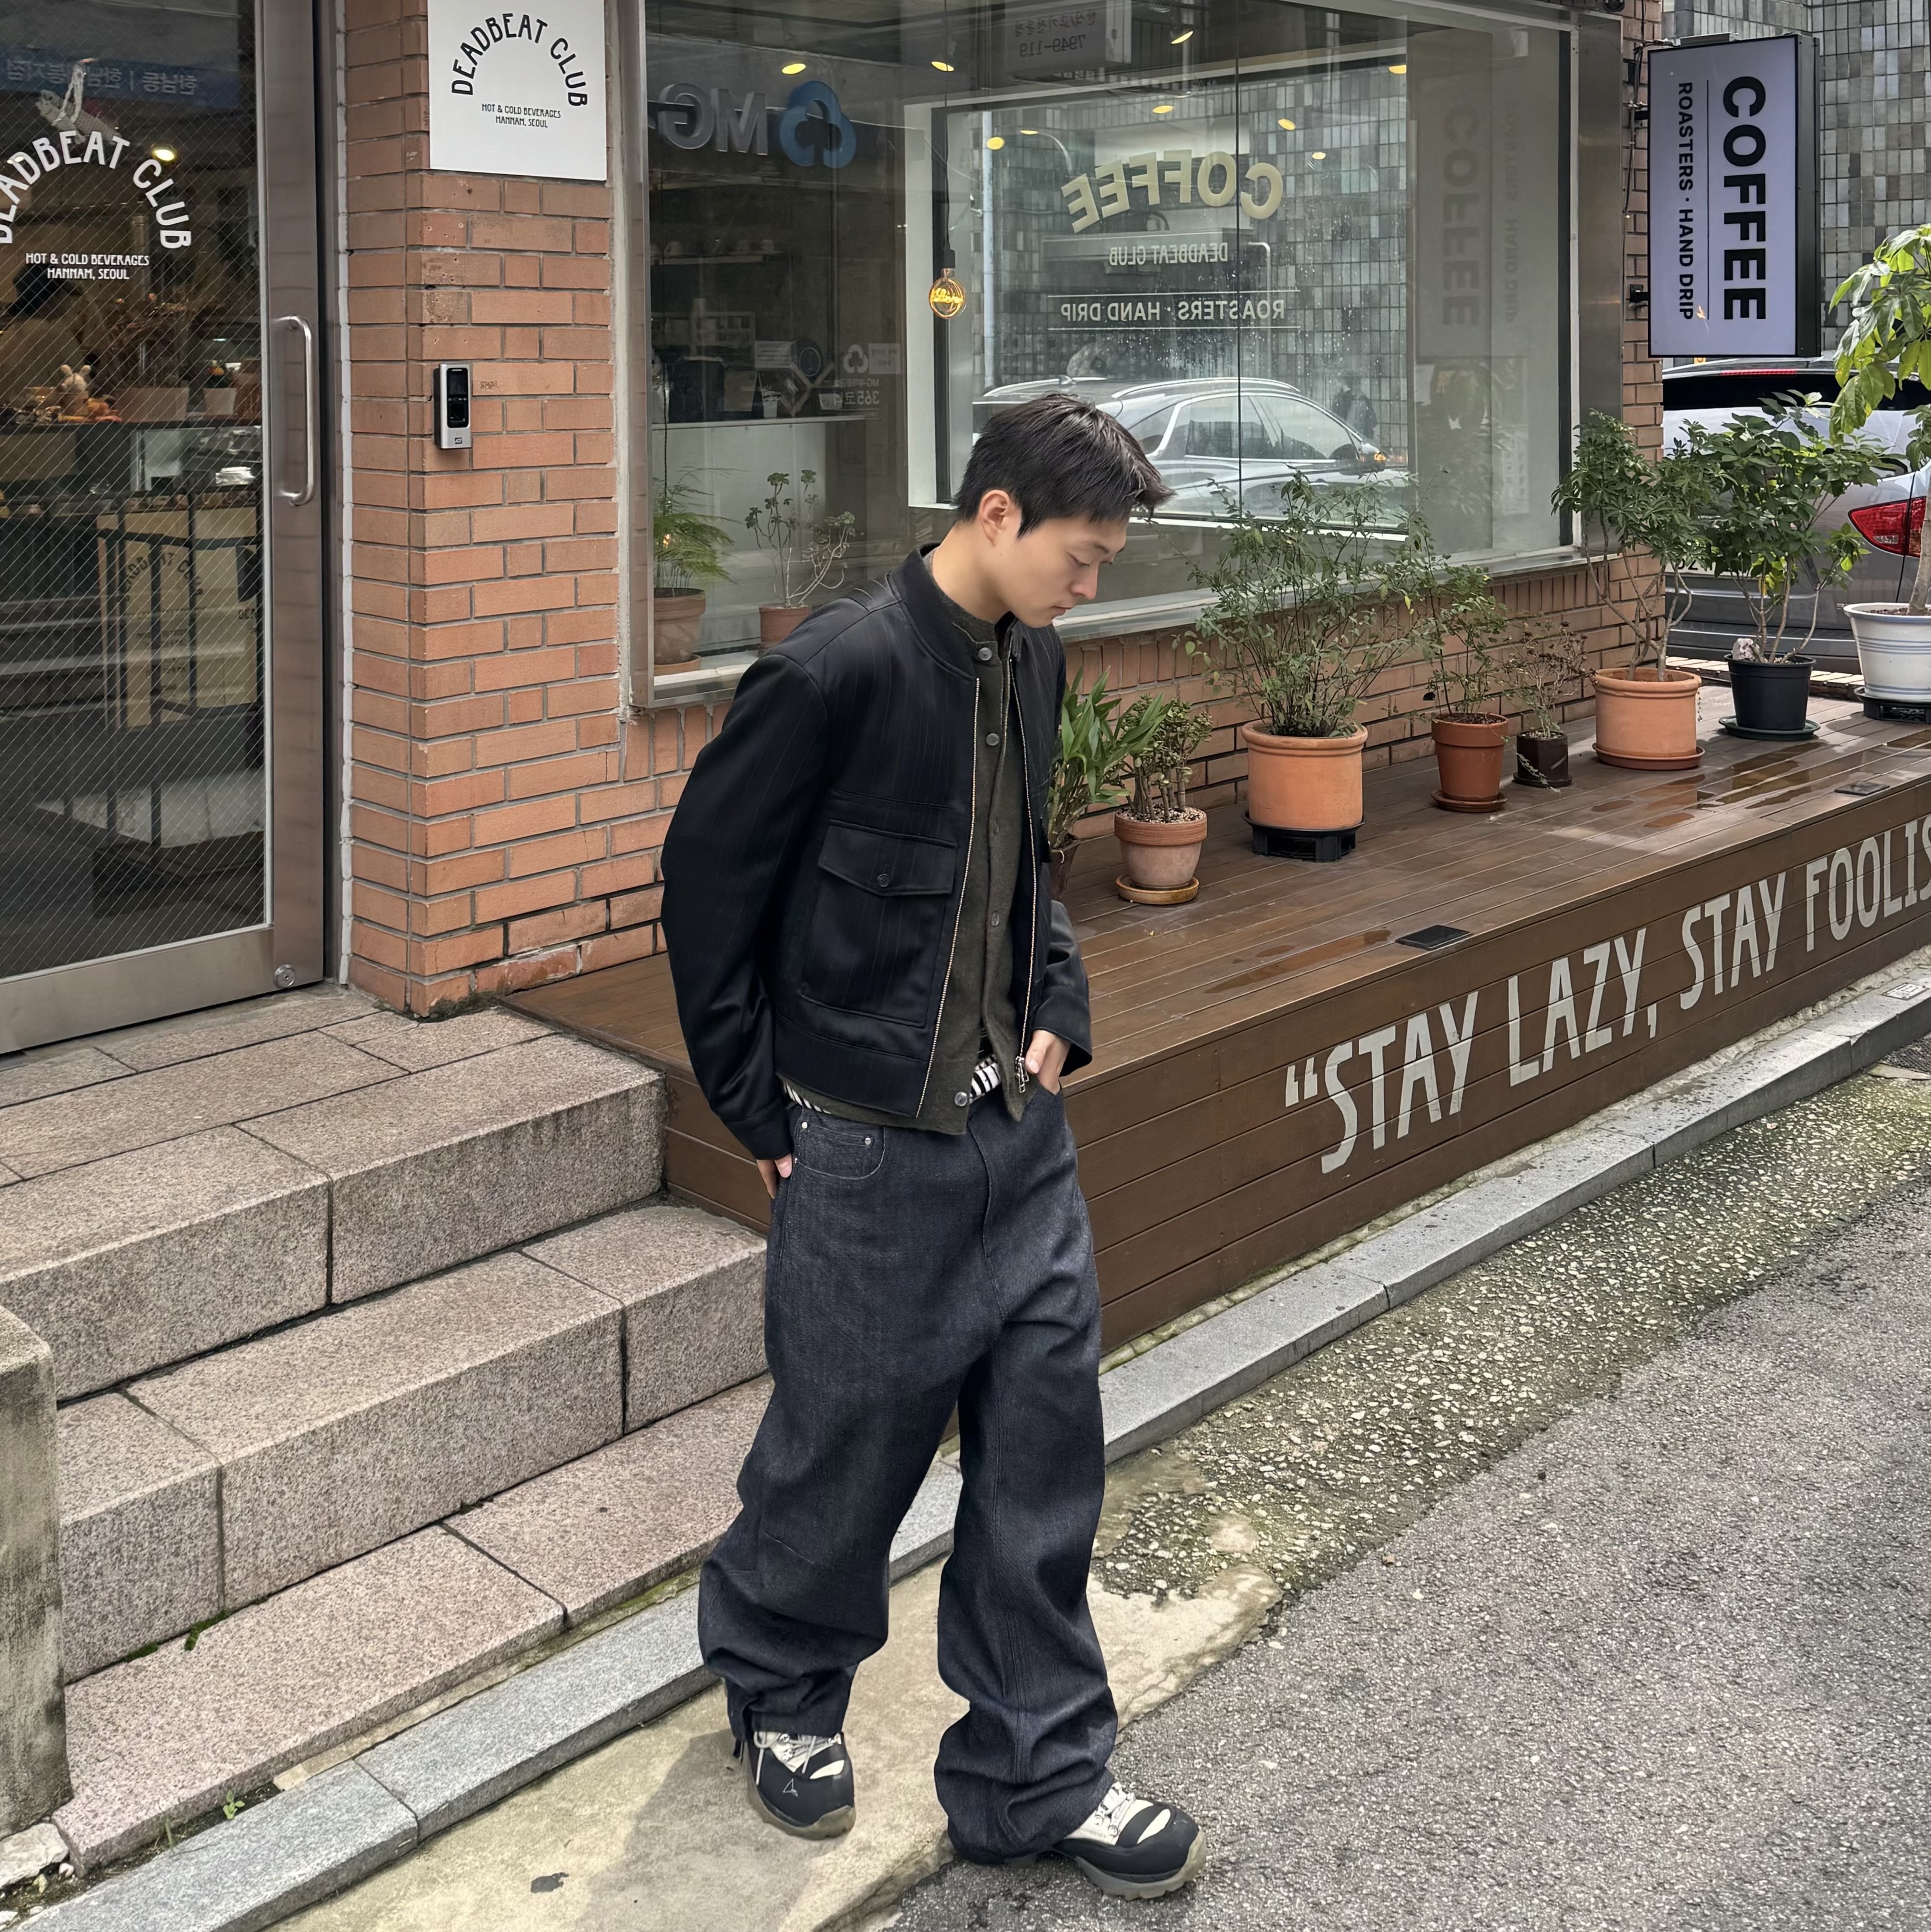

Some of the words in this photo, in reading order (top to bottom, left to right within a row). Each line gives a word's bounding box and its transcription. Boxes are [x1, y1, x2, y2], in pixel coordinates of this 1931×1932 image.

[451, 13, 548, 95] DEADBEAT
[550, 38, 588, 107] CLUB
[482, 103, 495, 112] HOT
[497, 104, 503, 113] &
[504, 105, 522, 115] COLD
[524, 107, 561, 119] BEVERAGES
[528, 118, 548, 128] SEOUL
[1678, 82, 1694, 192] ROASTERS
[133, 159, 191, 249] CLUB
[1723, 76, 1767, 320] COFFEE
[26, 253, 47, 264] HOT
[50, 254, 59, 264] &
[61, 253, 88, 265] COLD
[91, 254, 150, 266] BEVERAGES
[1678, 208, 1694, 267] HAND
[47, 267, 96, 280] HANNAM,
[98, 268, 130, 280] SEOUL
[1678, 273, 1694, 320] DRIP
[1508, 928, 1657, 1088] LAZY,
[1679, 871, 1786, 1011] STAY
